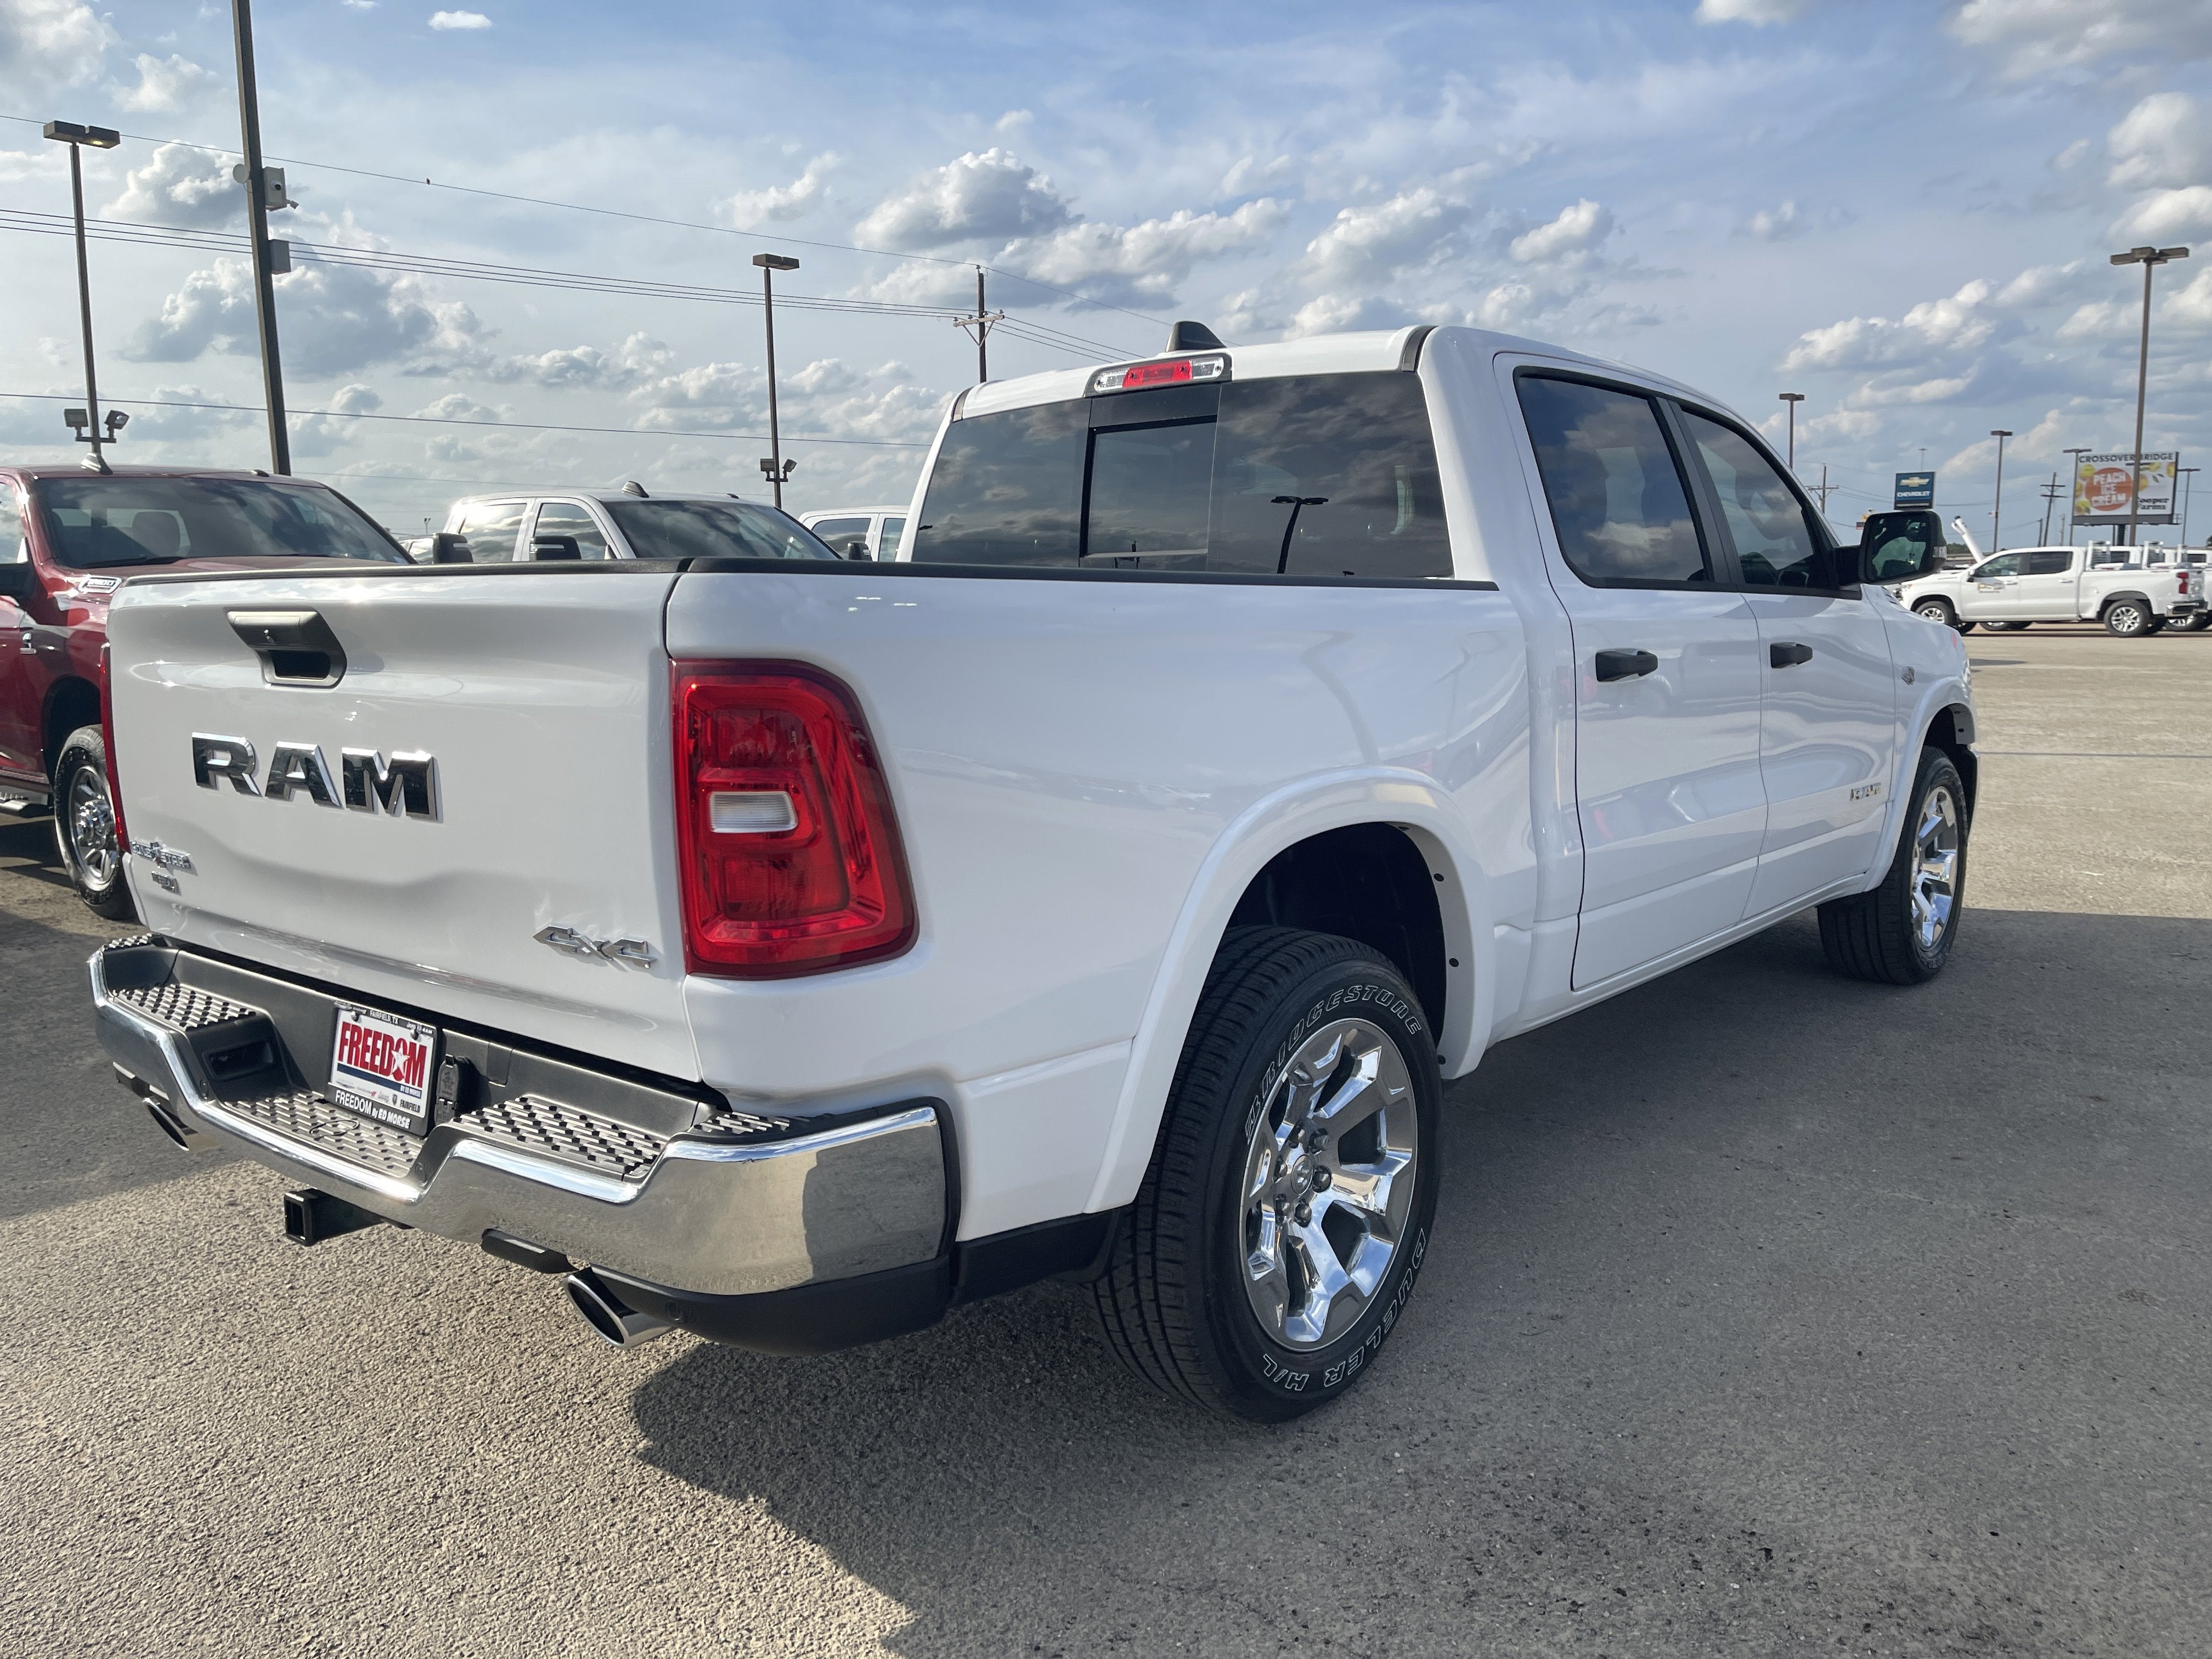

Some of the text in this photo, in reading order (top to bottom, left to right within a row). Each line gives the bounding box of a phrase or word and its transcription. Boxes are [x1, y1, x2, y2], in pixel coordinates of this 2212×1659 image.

[2079, 454, 2136, 463] CROSSOVER
[2093, 471, 2126, 486] PEACH
[2101, 484, 2117, 494] ICE
[2091, 493, 2126, 507] CREAM
[192, 732, 438, 821] RAM
[392, 1015, 399, 1025] TX
[337, 1022, 427, 1088] FREEDOM
[1245, 985, 1422, 1146] BRIDGESTONE
[335, 1090, 411, 1130] FREEDOM by ED MORSE
[399, 1099, 421, 1114] FAIRFIELD
[1262, 1227, 1426, 1391] DUELER H/L
